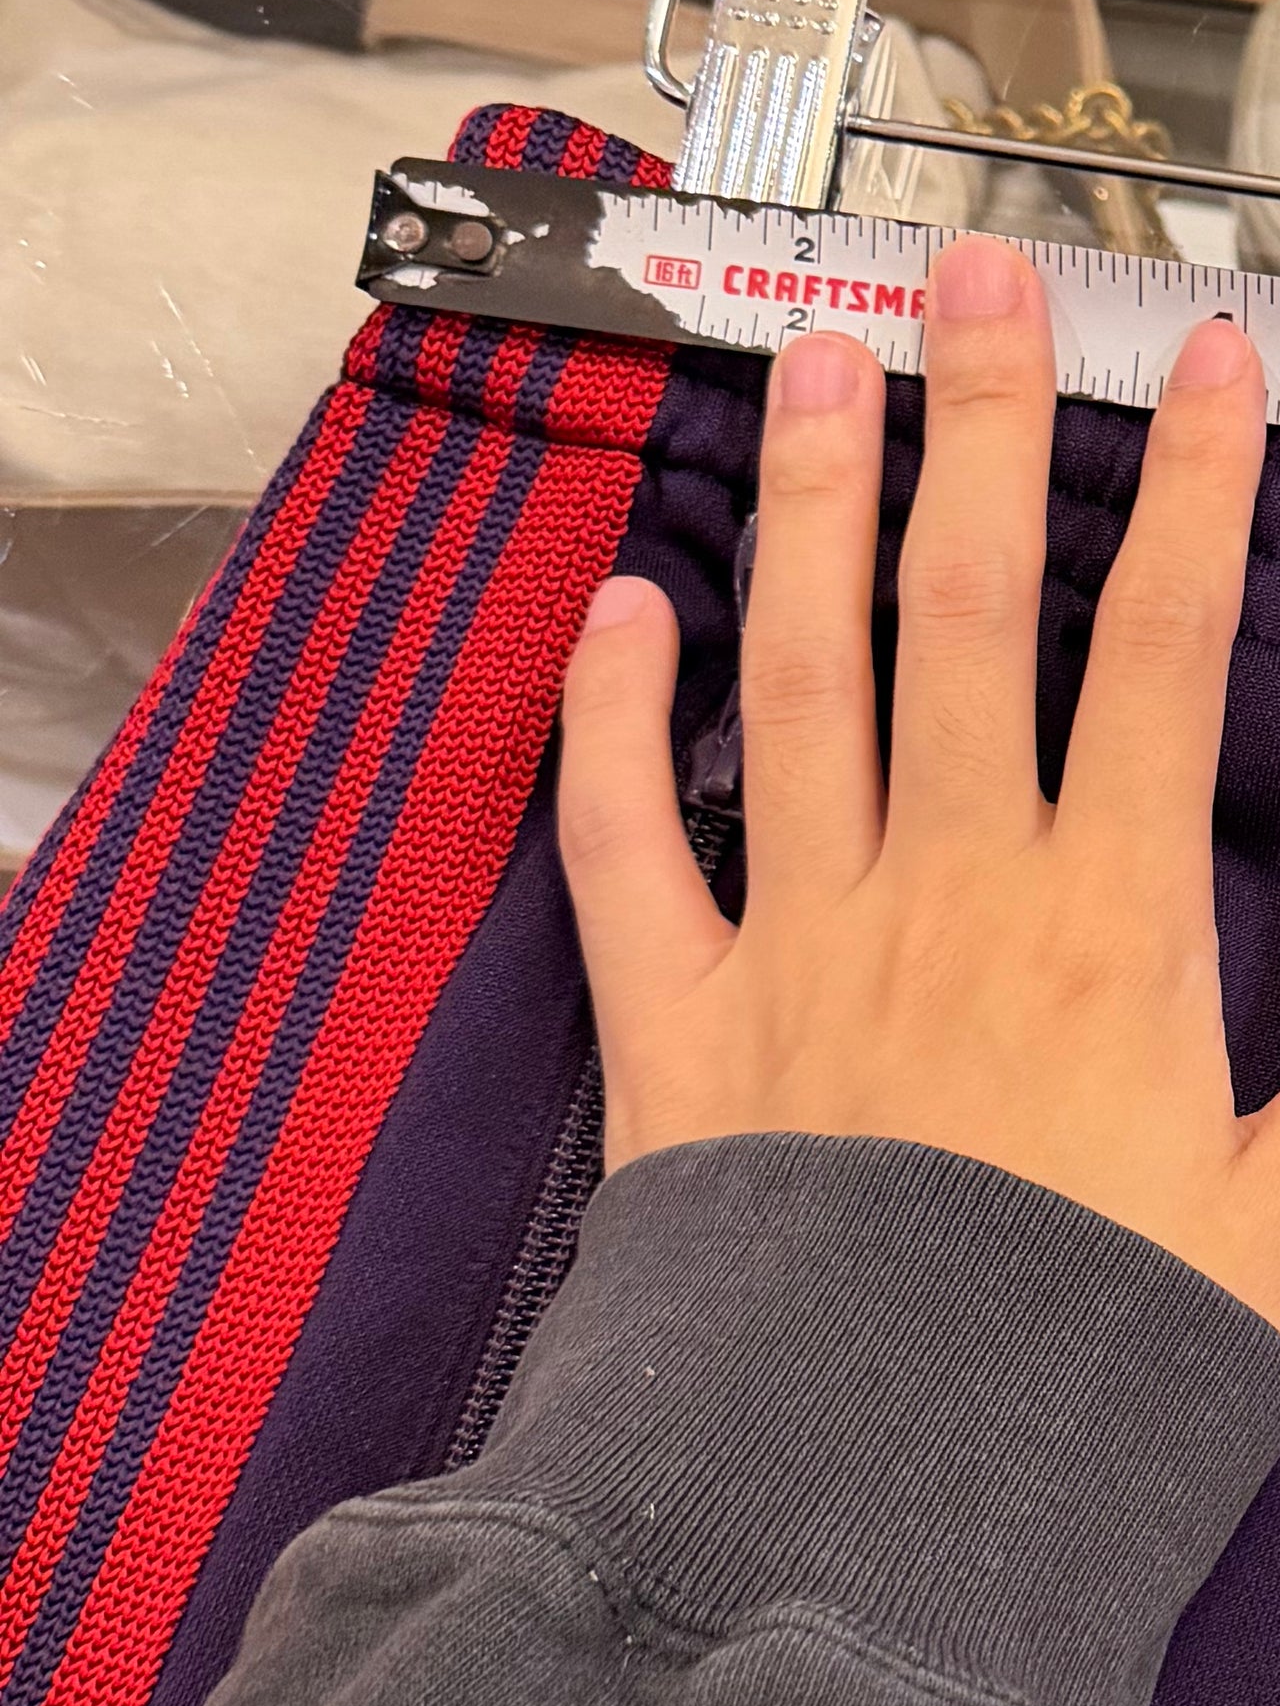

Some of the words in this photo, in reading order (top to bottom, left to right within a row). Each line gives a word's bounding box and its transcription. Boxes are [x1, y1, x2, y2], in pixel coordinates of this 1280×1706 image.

[794, 237, 815, 263] 2
[723, 264, 926, 320] CRAFTSMA
[786, 307, 808, 332] 2
